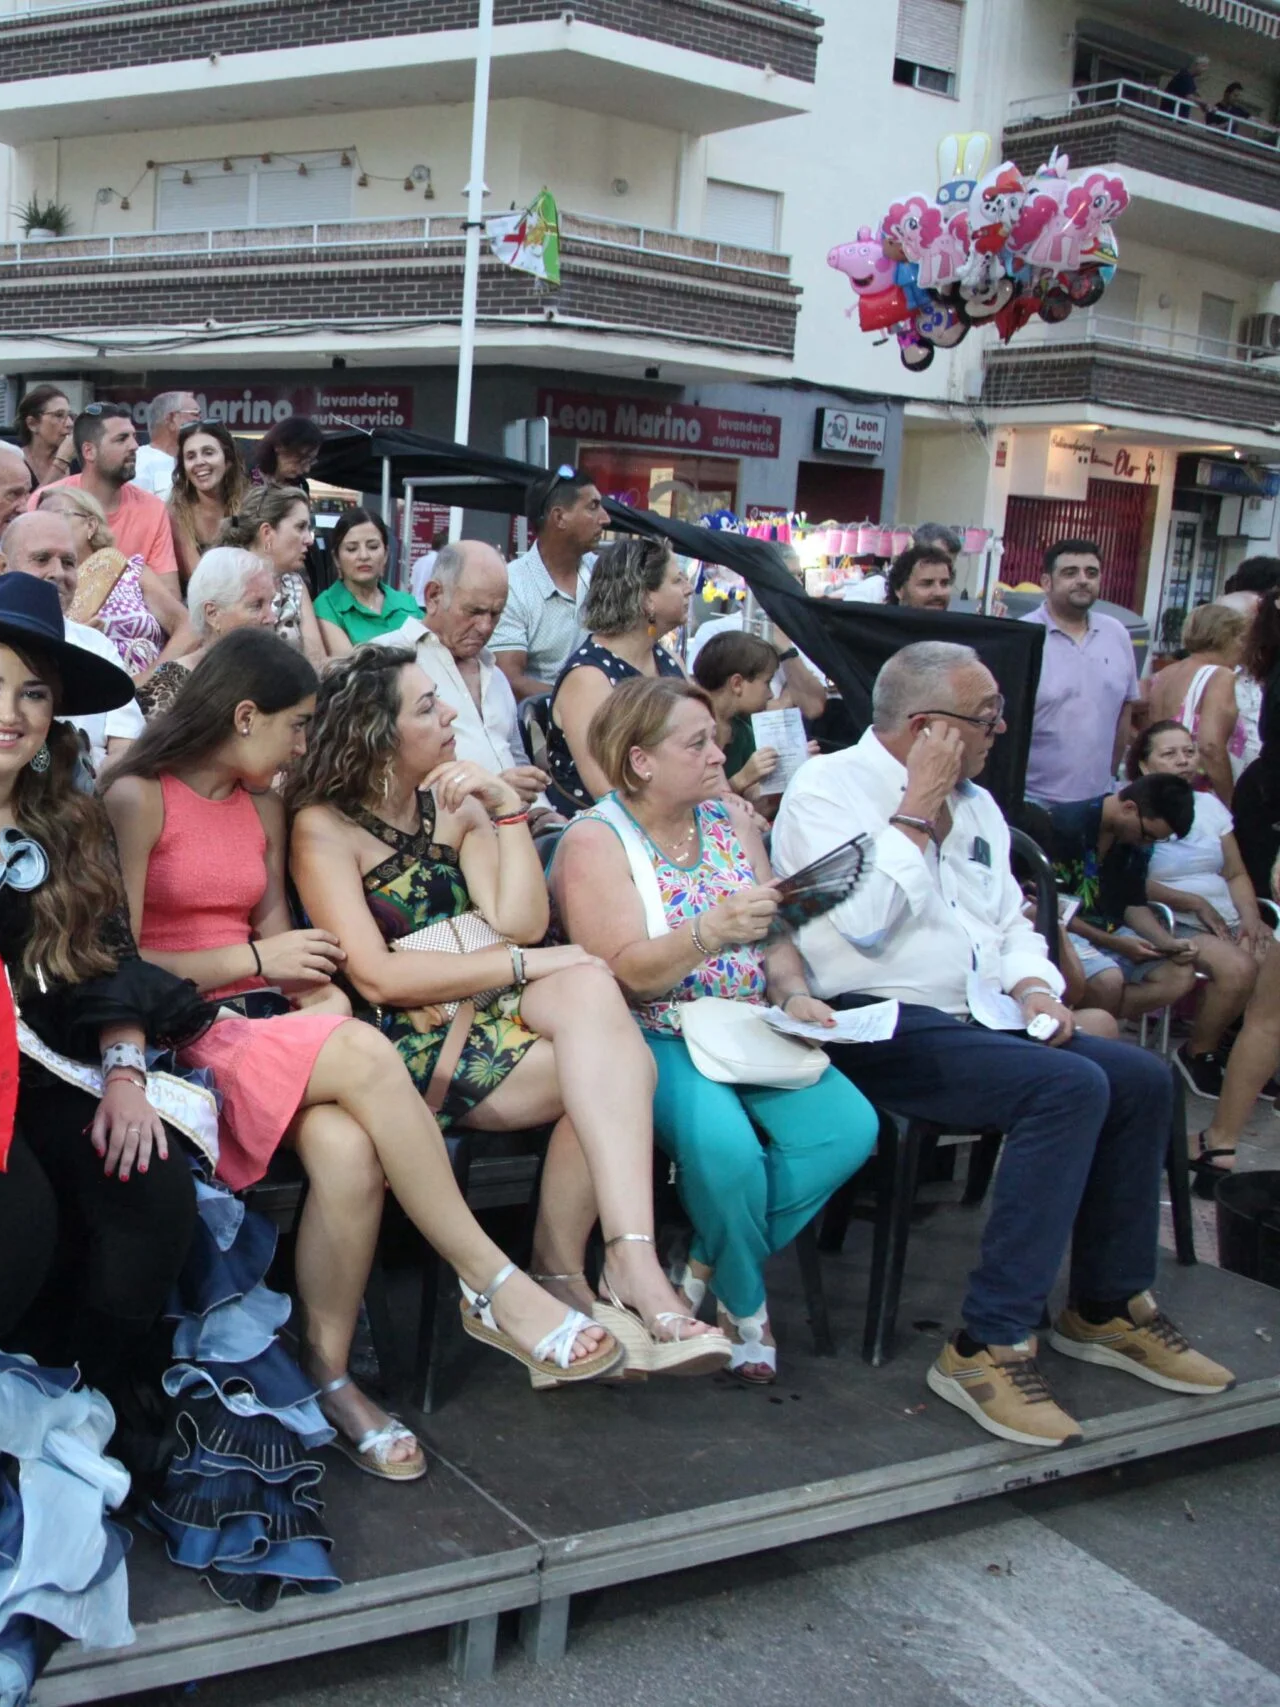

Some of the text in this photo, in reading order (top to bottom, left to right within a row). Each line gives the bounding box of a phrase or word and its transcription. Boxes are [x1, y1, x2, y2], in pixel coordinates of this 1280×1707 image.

[316, 391, 399, 408] lavanderia
[310, 410, 405, 427] autoservicio
[545, 395, 702, 444] Leon Marino
[717, 414, 774, 436] lavanderia
[855, 415, 879, 433] Leon
[711, 435, 776, 453] autoservicio
[847, 434, 883, 452] Marino
